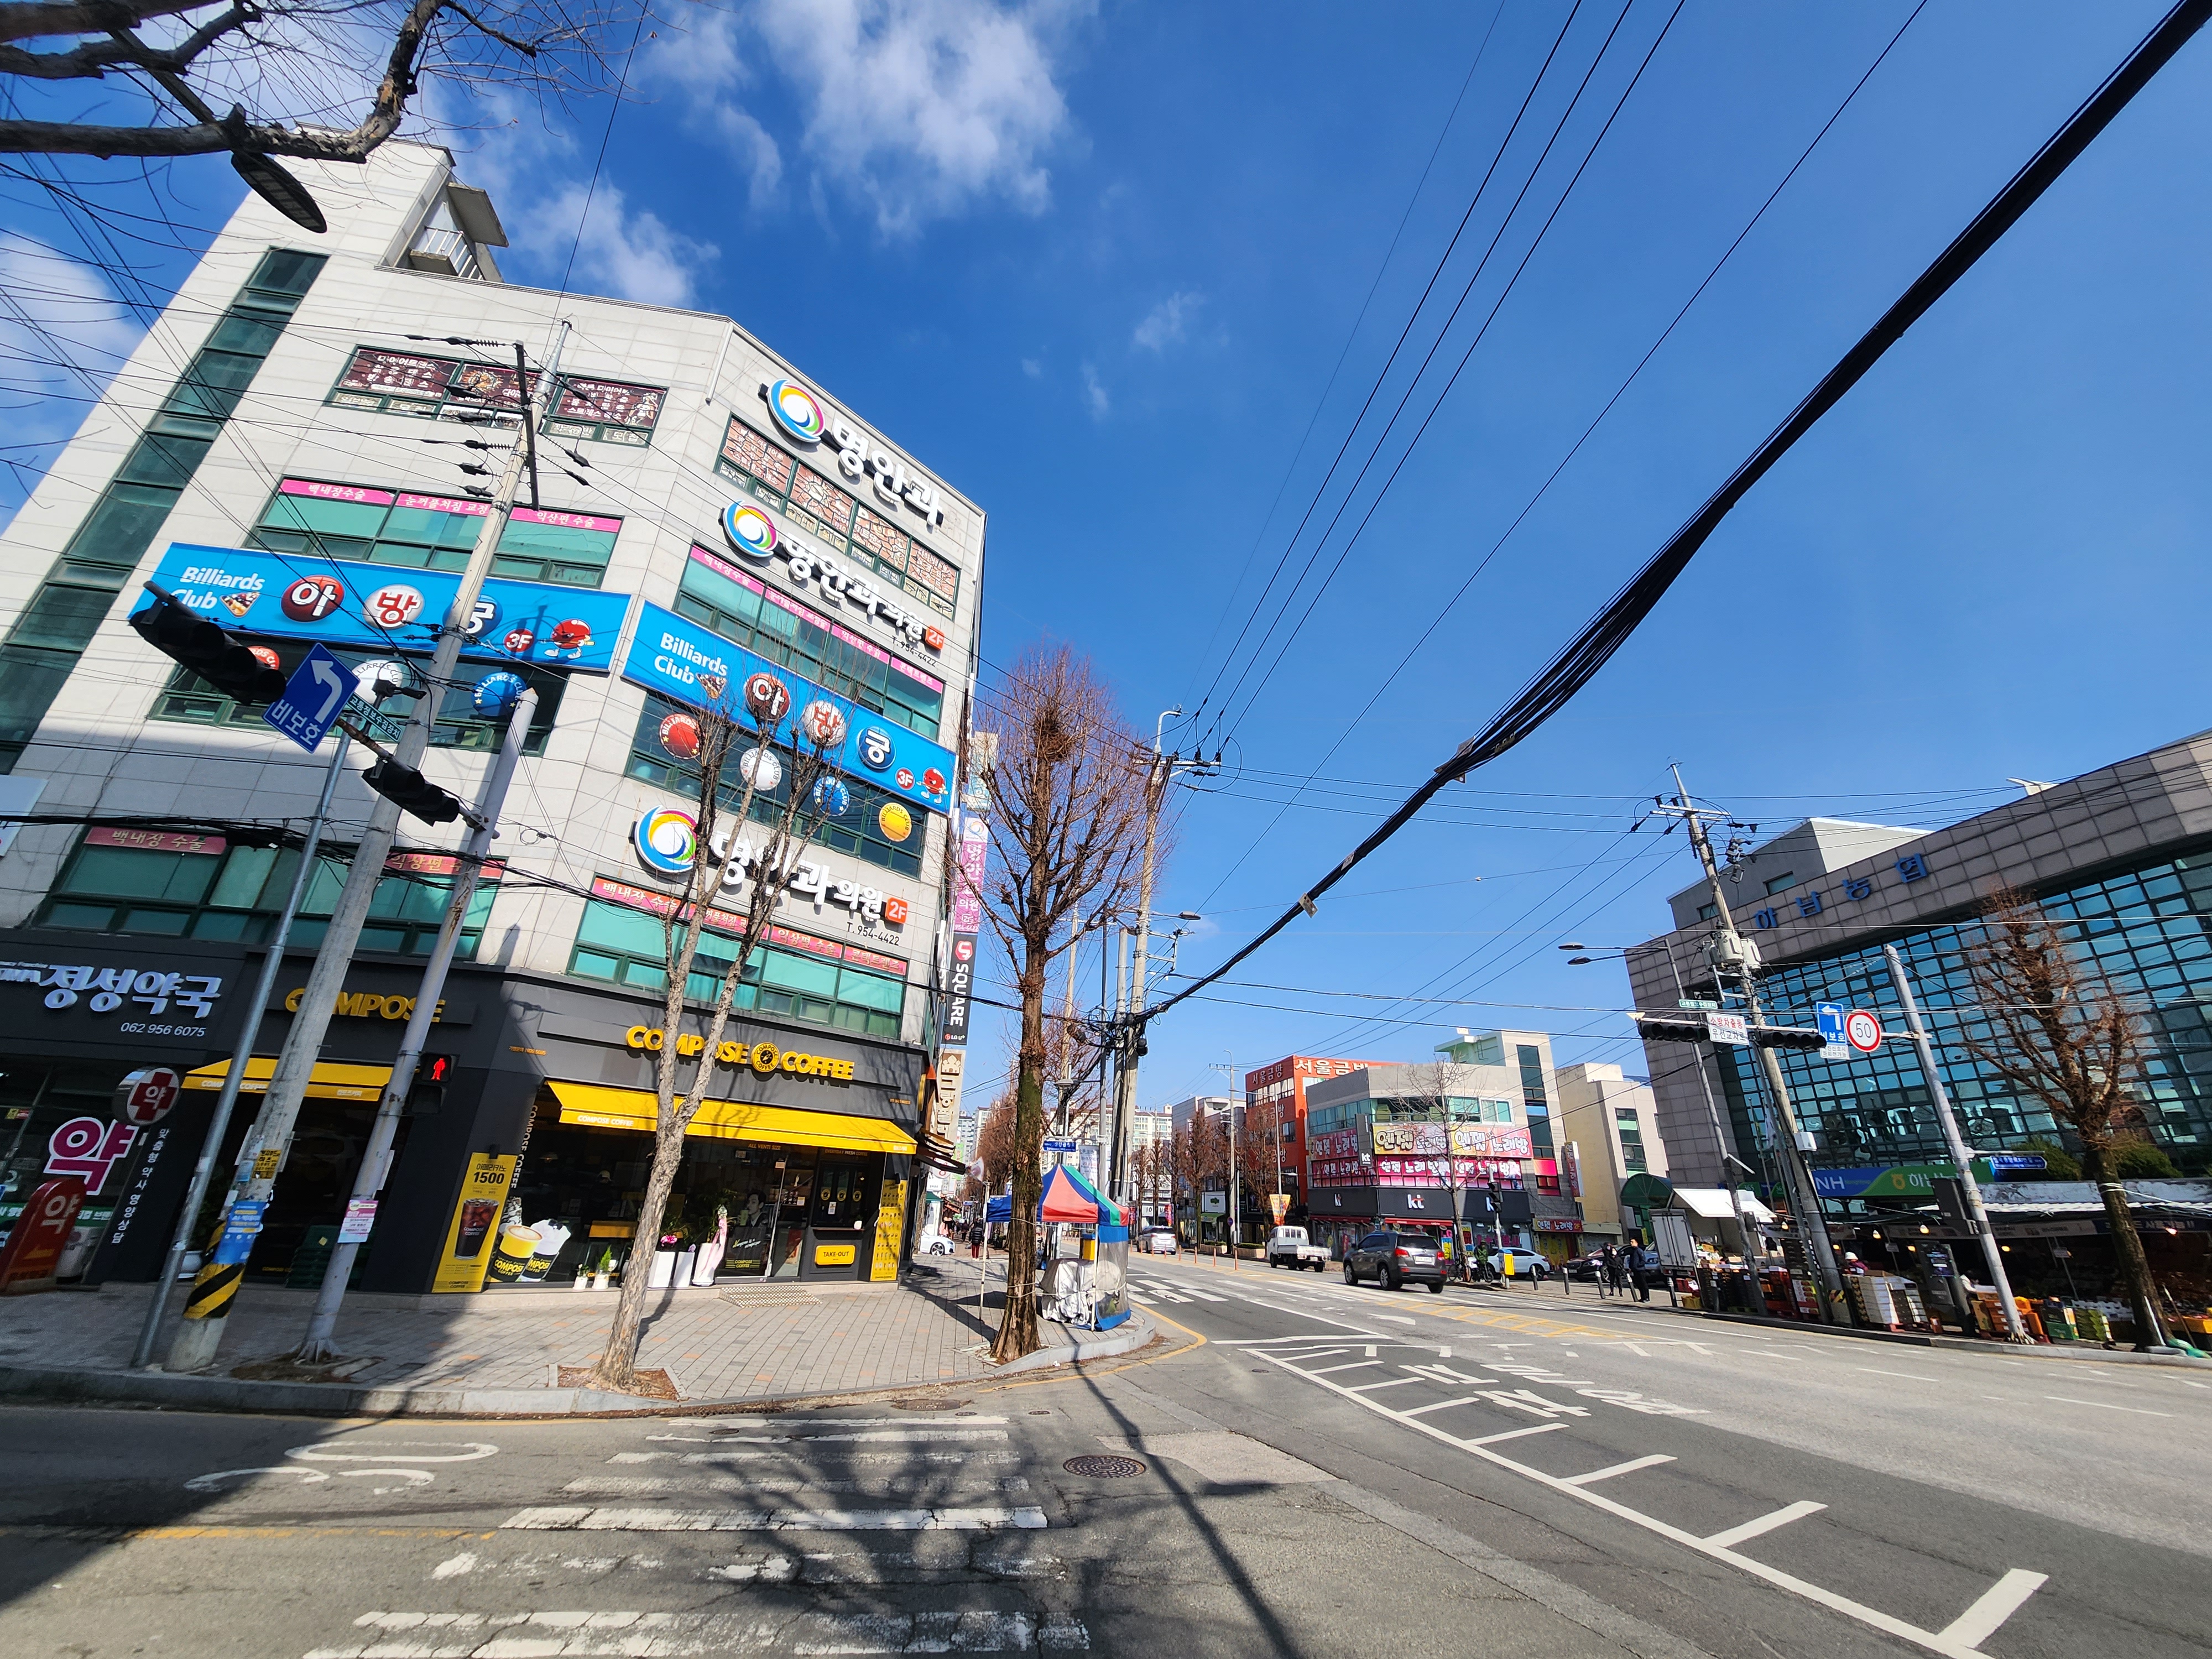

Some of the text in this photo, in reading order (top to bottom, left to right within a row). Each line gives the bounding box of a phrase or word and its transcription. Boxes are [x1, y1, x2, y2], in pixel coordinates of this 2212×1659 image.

[833, 418, 942, 526] 명안과
[308, 484, 366, 500] 백내장수술
[181, 566, 265, 592] Billiards
[171, 588, 217, 610] Club
[507, 631, 531, 650] 3F
[929, 629, 944, 646] 2F
[659, 632, 728, 677] Billiards
[654, 655, 695, 685] Club
[271, 699, 321, 746] 비보호
[349, 695, 399, 739] 교통정보수집장치
[897, 771, 914, 787] 3F
[881, 806, 904, 823] BILLIARDS
[112, 830, 165, 850] 백내장
[603, 882, 645, 904] 백내장
[889, 901, 907, 919] 2F
[778, 929, 836, 956] 익상편 수술
[852, 949, 899, 969] 콘택트렌즈
[950, 963, 969, 1027] SQUARE
[285, 988, 446, 1023] CMPOSE
[121, 1022, 206, 1037] 062 956 6075
[1710, 1017, 1743, 1029] 소방차출동
[1856, 1022, 1871, 1038] 50
[1712, 1029, 1746, 1041] 우선교차로
[626, 1026, 855, 1081] COMPSE COFFEE
[756, 1044, 778, 1058] COMPOSE
[756, 1060, 775, 1071] COFFEE
[1252, 1063, 1284, 1084] 서울금방
[146, 1086, 166, 1110] 약
[520, 1105, 538, 1152] COMPOSE
[577, 1115, 634, 1126] COMPOSE COFFEE
[1493, 1137, 1528, 1154] 노래방
[44, 1117, 139, 1196] 약
[1361, 1152, 1370, 1162] kt
[476, 1163, 507, 1172] 아메리카노
[135, 1167, 153, 1190] 약사
[473, 1172, 505, 1184] 1500
[1816, 1175, 1845, 1190] NH
[1334, 1193, 1342, 1207] kt
[1407, 1194, 1425, 1209] kt
[41, 1194, 81, 1234] 약
[112, 1194, 141, 1244] 영양상담
[527, 1259, 550, 1270] MPOSE
